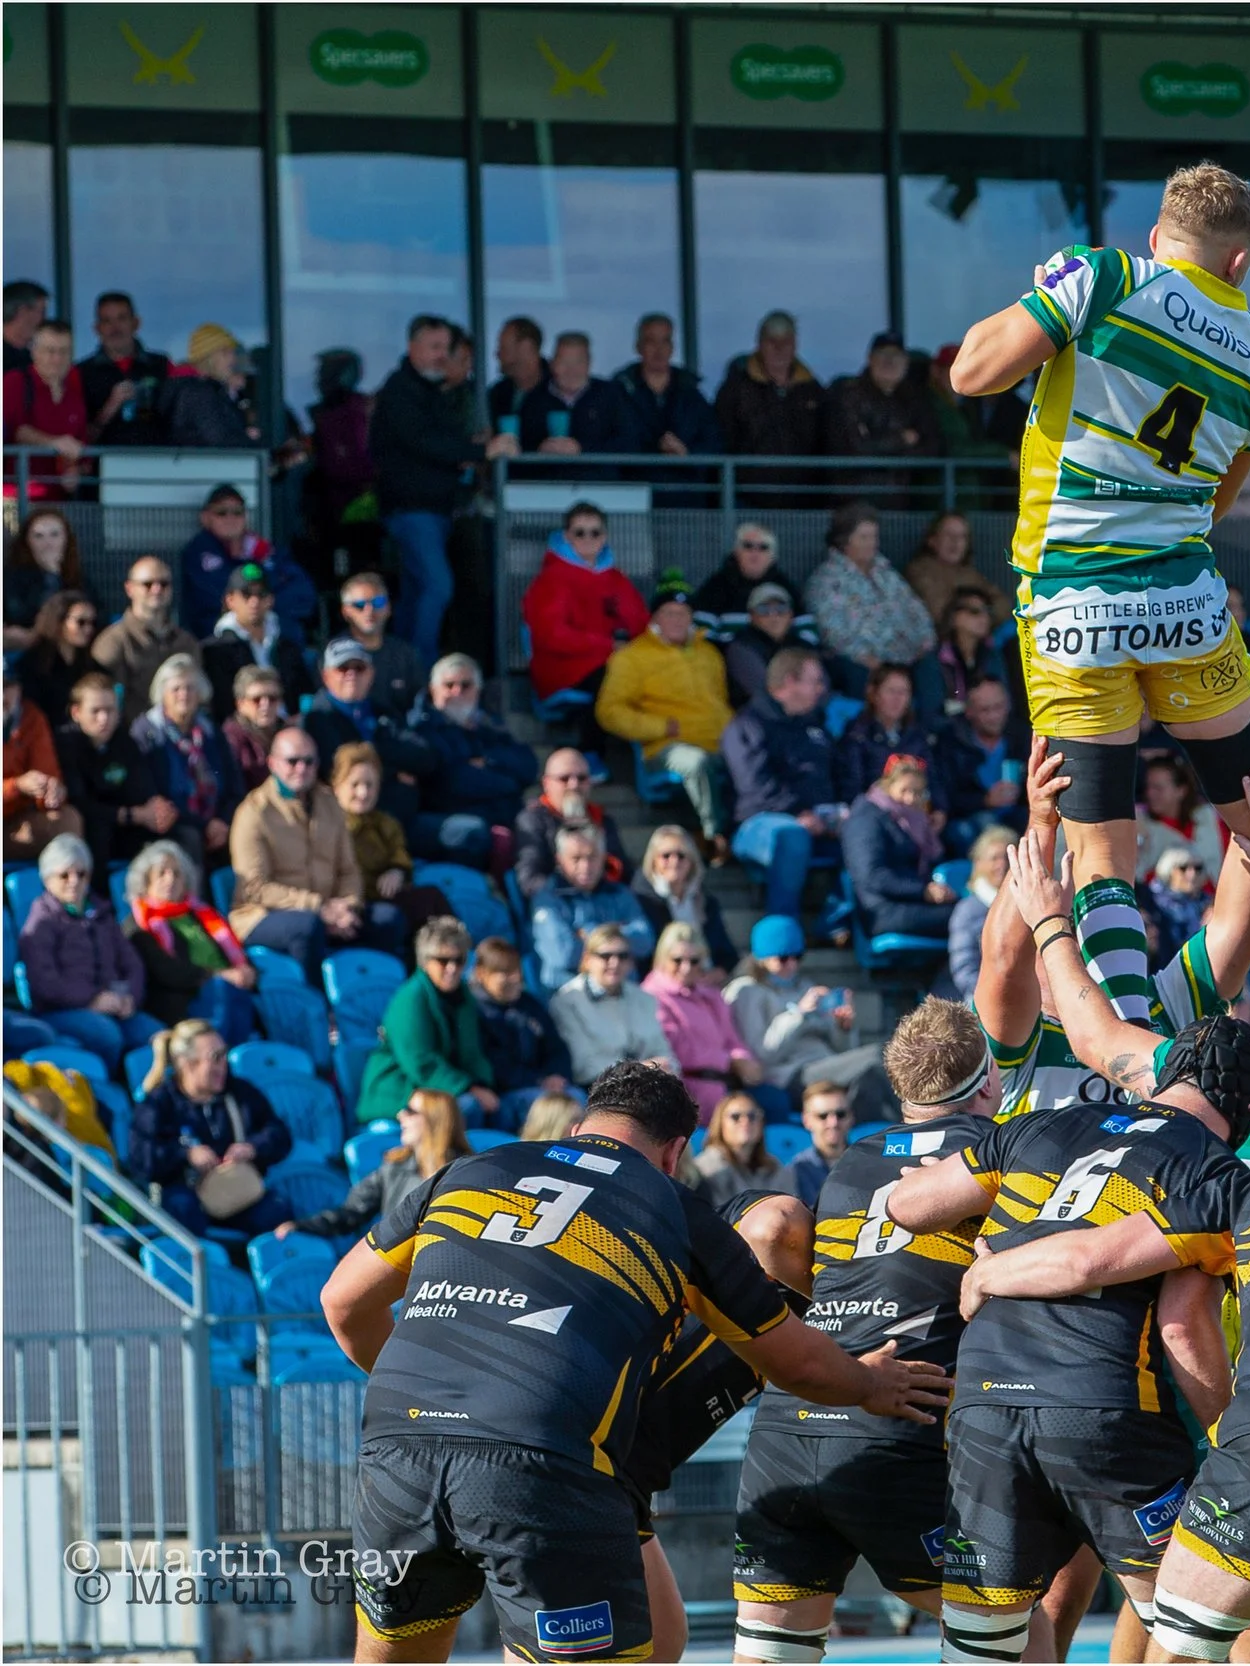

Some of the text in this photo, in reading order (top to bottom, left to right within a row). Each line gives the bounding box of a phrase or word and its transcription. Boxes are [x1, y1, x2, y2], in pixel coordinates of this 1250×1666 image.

[1136, 382, 1209, 476] 4
[1073, 603, 1132, 621] LITTLE
[1136, 602, 1162, 617] BIG
[1166, 595, 1206, 616] BREW
[1046, 619, 1204, 655] BOTTOMS
[547, 1150, 571, 1163] BCL
[886, 1144, 907, 1155] BCL
[1034, 1147, 1132, 1221] 6
[479, 1176, 594, 1248] 3
[412, 1279, 529, 1309] Advanta
[404, 1303, 458, 1320] Wealth
[991, 1382, 1035, 1391] AKUMA
[419, 1410, 469, 1420] AKUMA
[807, 1412, 849, 1421] AKUMA
[1215, 1521, 1245, 1541] HILLS
[545, 1617, 605, 1635] Colliers
